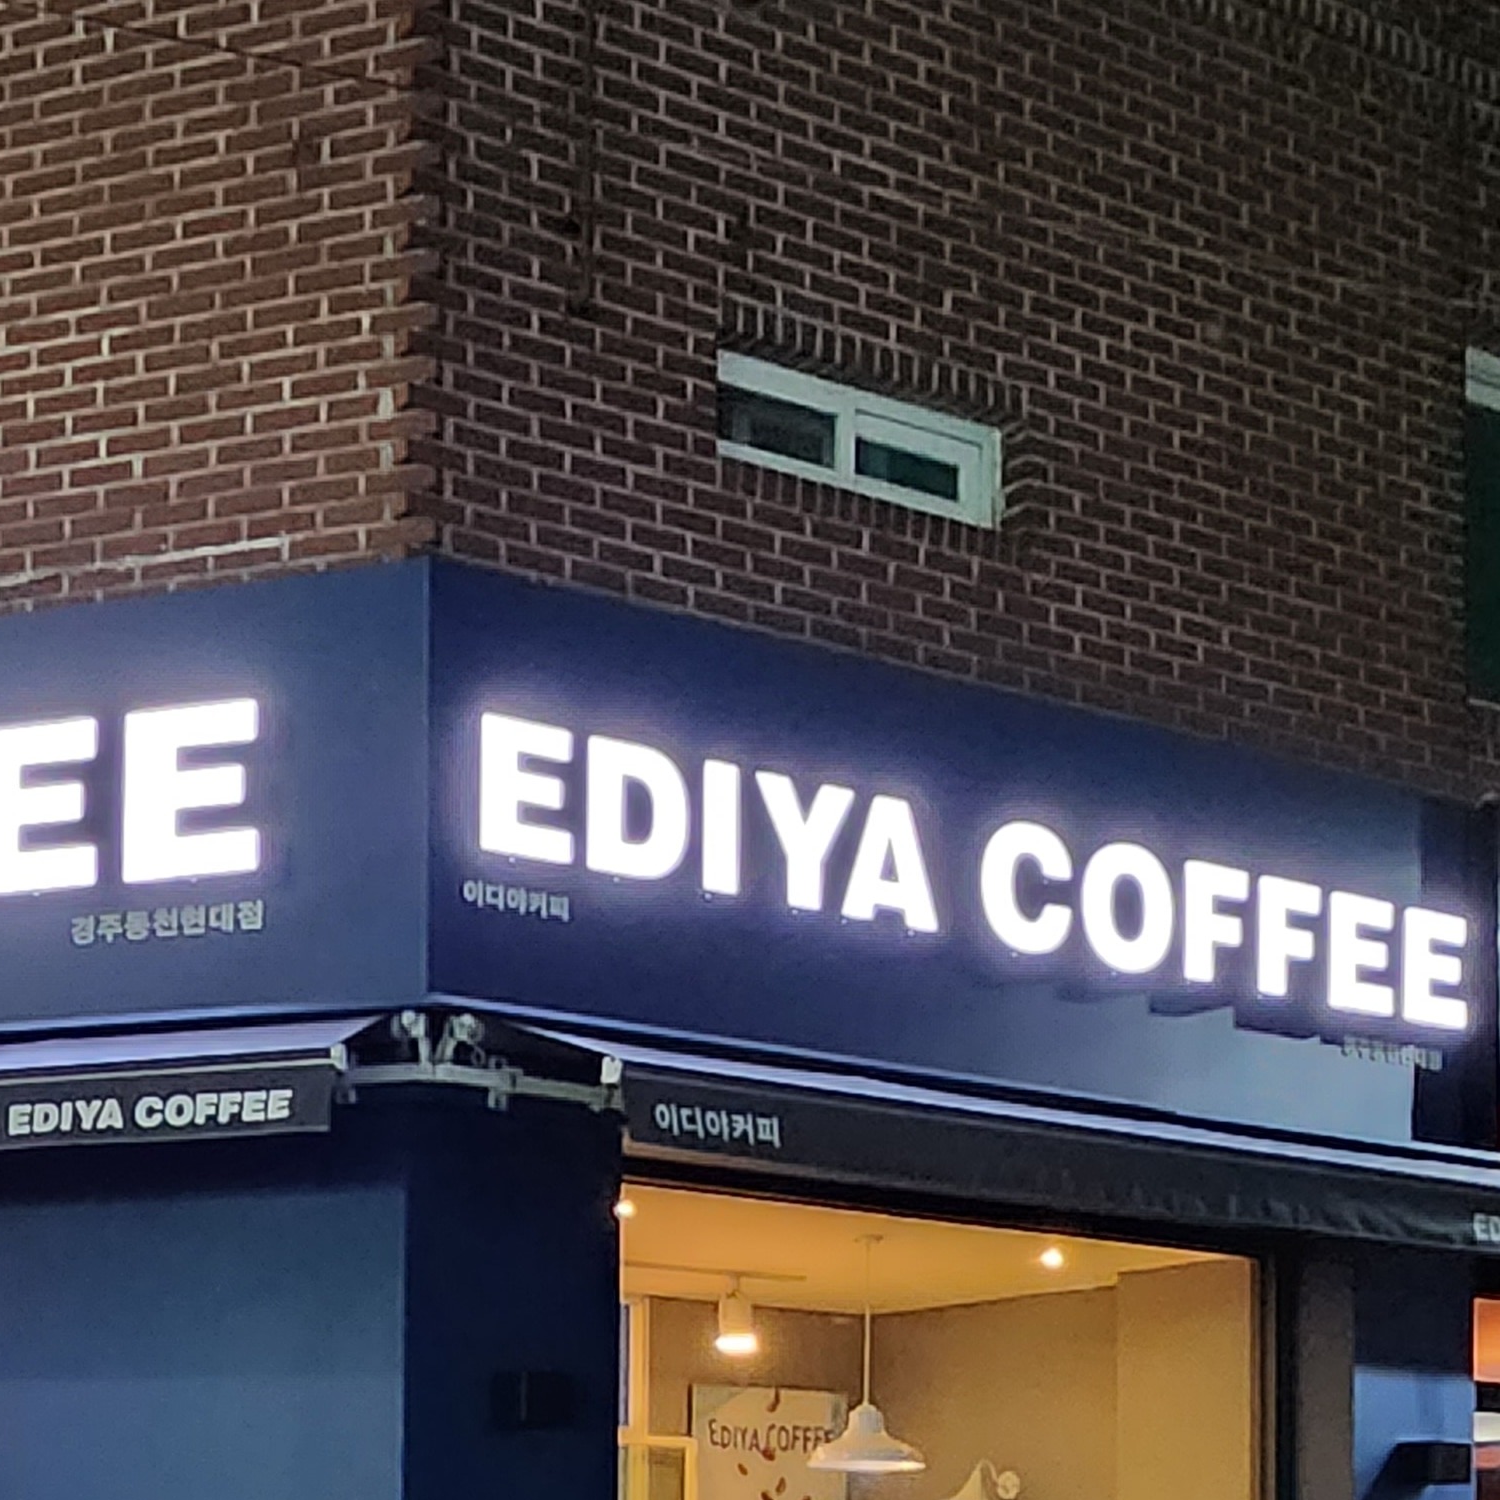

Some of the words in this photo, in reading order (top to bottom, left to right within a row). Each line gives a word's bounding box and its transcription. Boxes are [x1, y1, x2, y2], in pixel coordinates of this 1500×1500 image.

[479, 711, 940, 933] EDIYA
[980, 820, 1469, 1030] COFFEE
[463, 880, 570, 923] 이디야커피
[8, 1098, 124, 1136] EDIYA
[134, 1089, 293, 1129] COFFEE
[654, 1102, 781, 1149] 이디야커피
[708, 1418, 760, 1451] EDIYA
